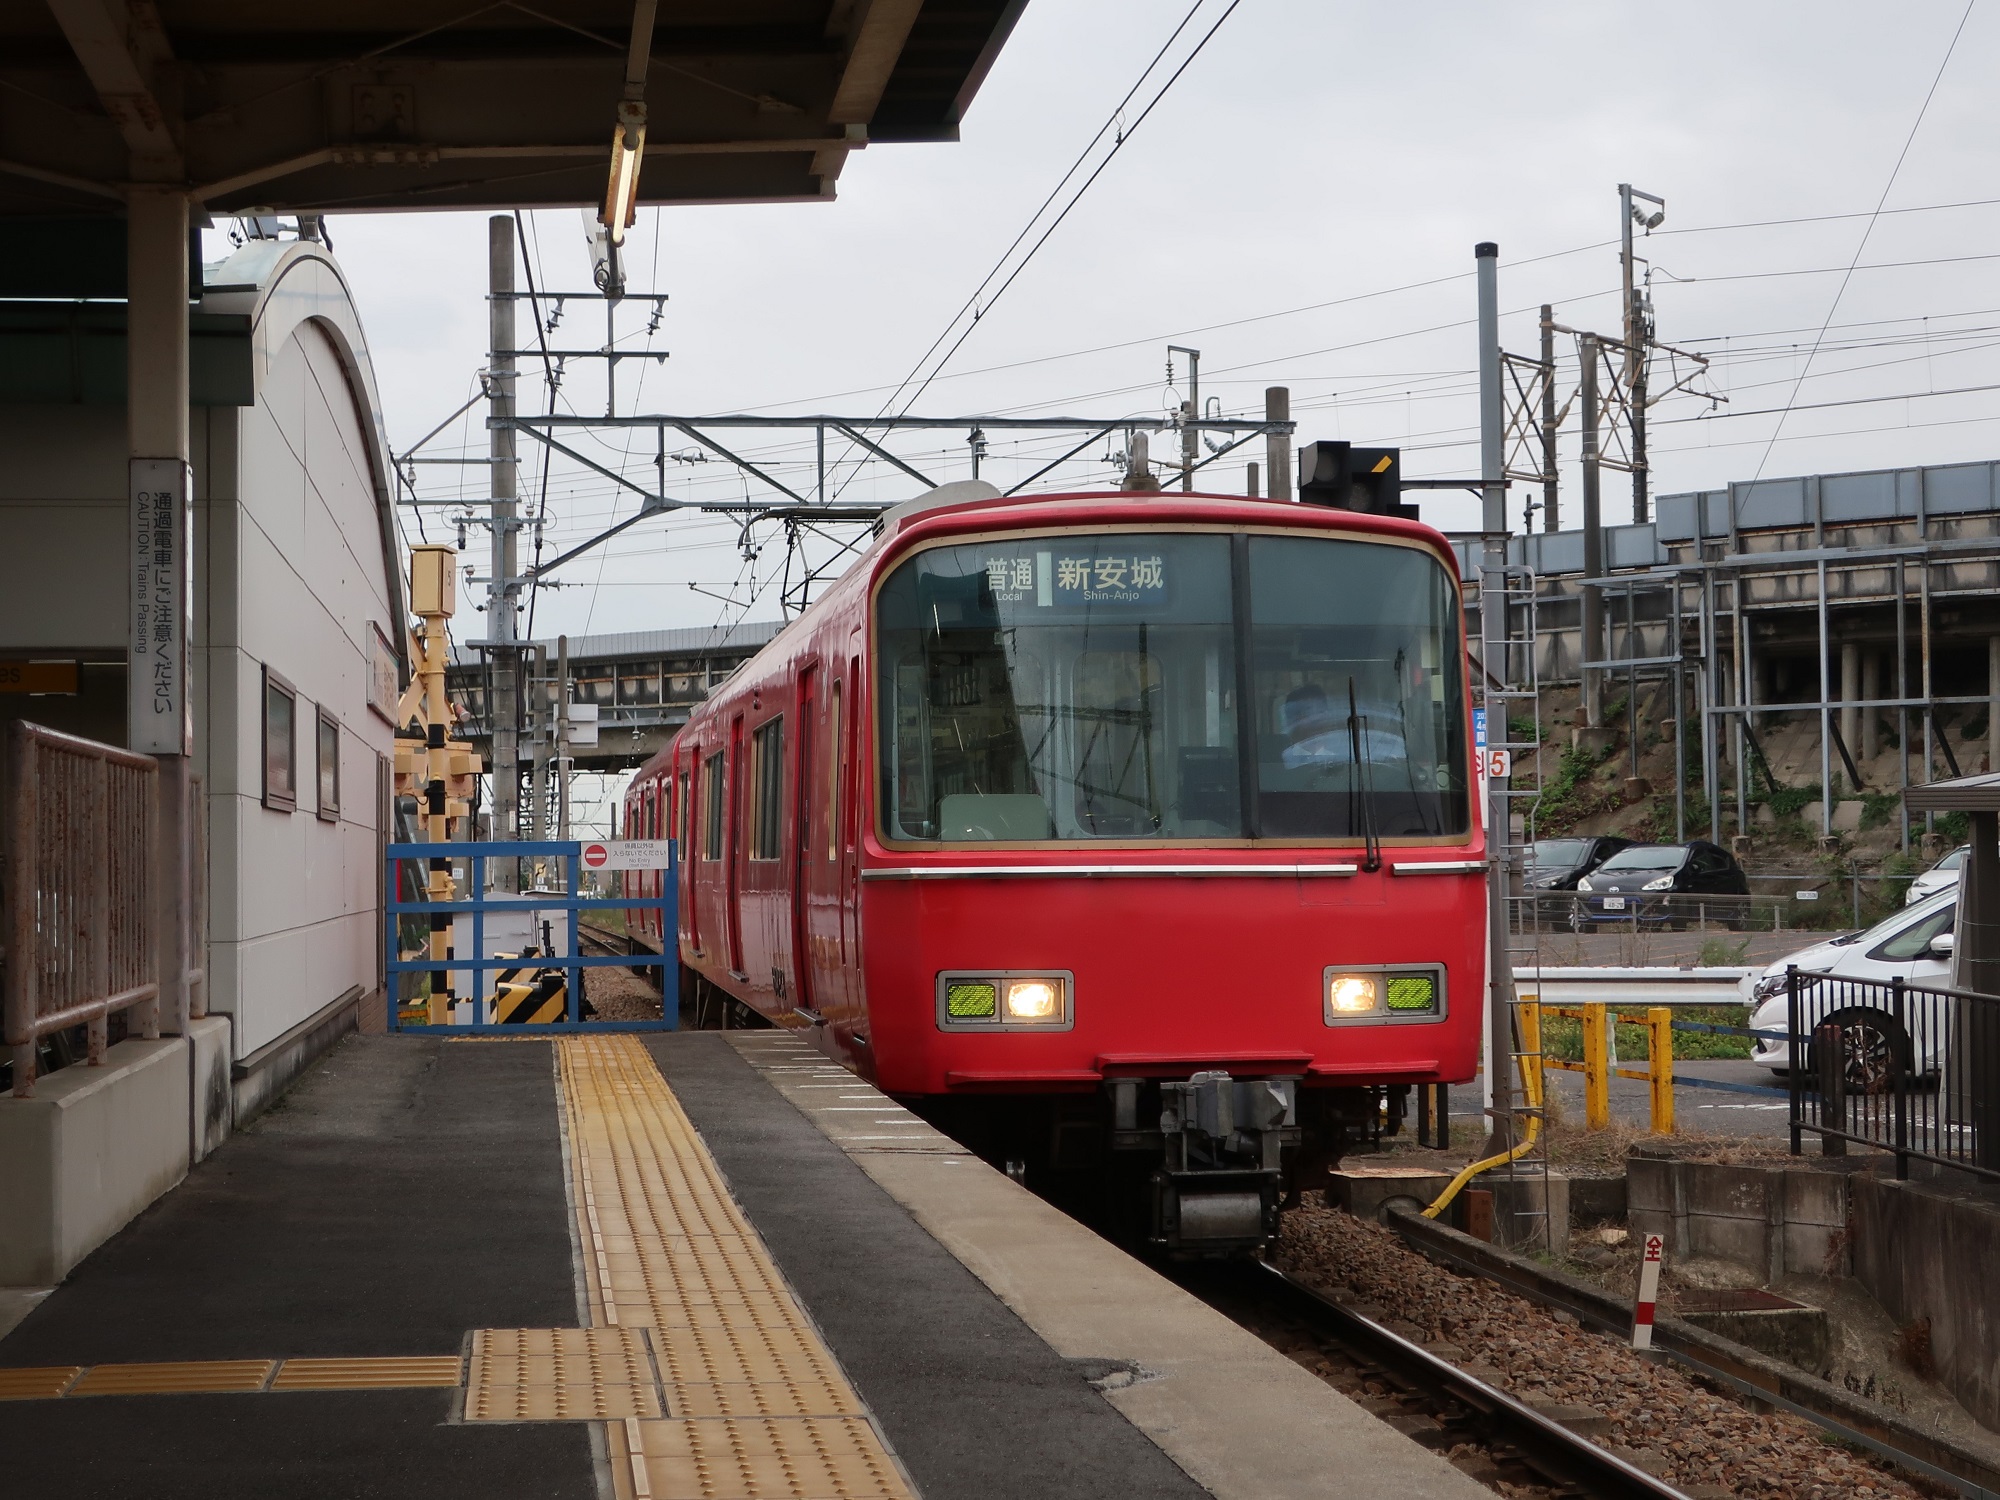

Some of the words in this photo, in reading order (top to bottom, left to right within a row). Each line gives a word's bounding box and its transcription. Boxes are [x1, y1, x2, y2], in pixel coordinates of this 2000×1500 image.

[137, 562, 149, 600] Trains
[986, 557, 1033, 590] 普通
[1057, 556, 1164, 590] 新安城
[153, 491, 173, 714] 通過電車にご注意ください
[996, 591, 1023, 601] Local
[1083, 591, 1140, 602] Shin-Anjo
[135, 604, 149, 654] Passing
[1491, 752, 1505, 776] 5
